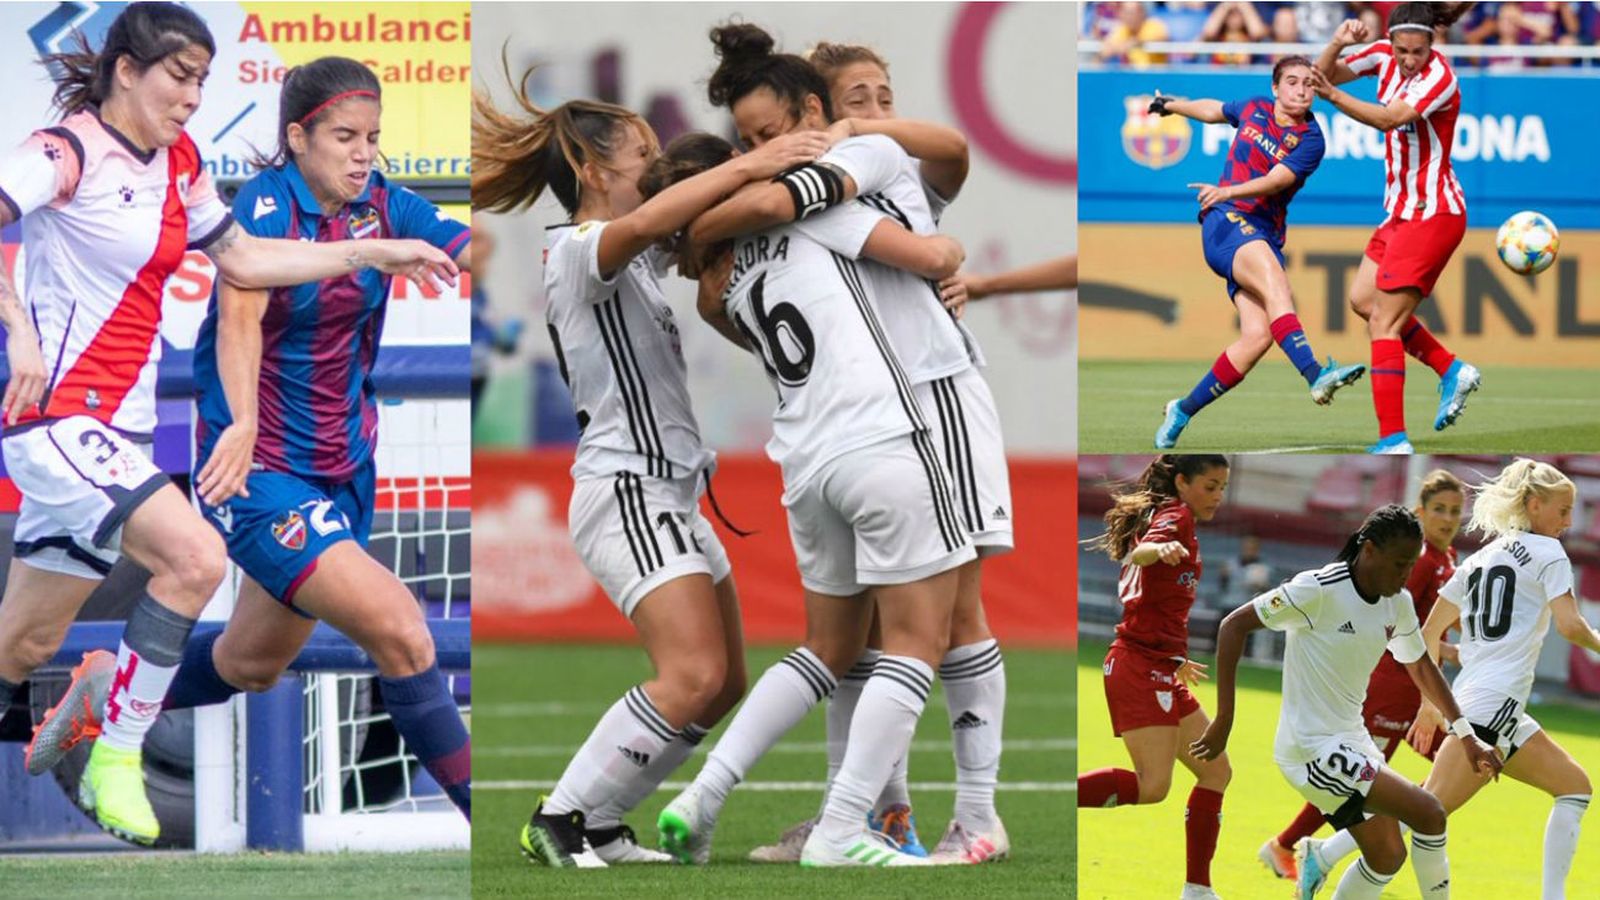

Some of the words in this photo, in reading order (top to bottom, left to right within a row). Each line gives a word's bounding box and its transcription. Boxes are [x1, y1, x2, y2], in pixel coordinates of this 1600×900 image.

[238, 13, 470, 43] Ambulanci
[238, 60, 285, 84] Sie
[79, 429, 119, 464] 3
[1465, 565, 1516, 642] 10
